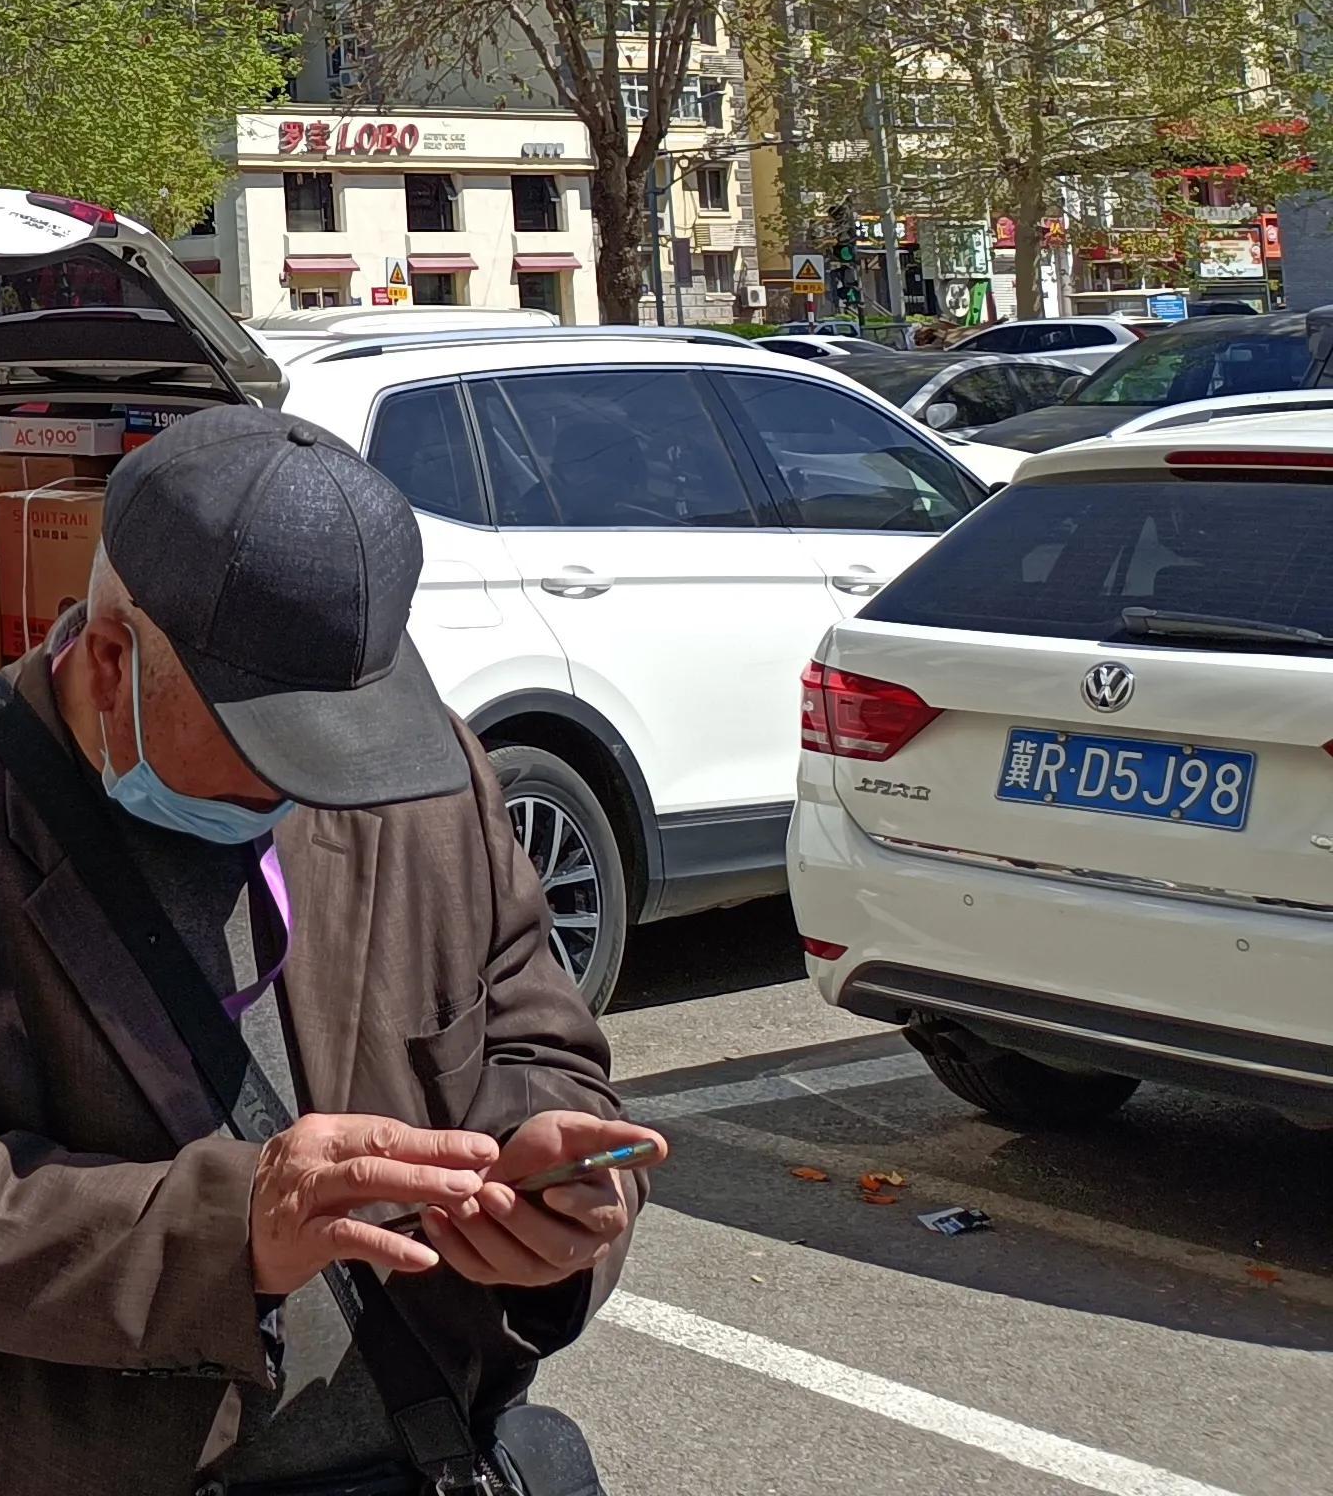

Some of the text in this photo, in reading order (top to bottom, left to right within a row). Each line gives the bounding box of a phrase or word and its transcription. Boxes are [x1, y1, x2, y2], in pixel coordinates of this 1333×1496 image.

[336, 123, 419, 154] LOBO
[13, 509, 89, 526] SONTRAN
[1004, 739, 1243, 816] 冀R·D5J98
